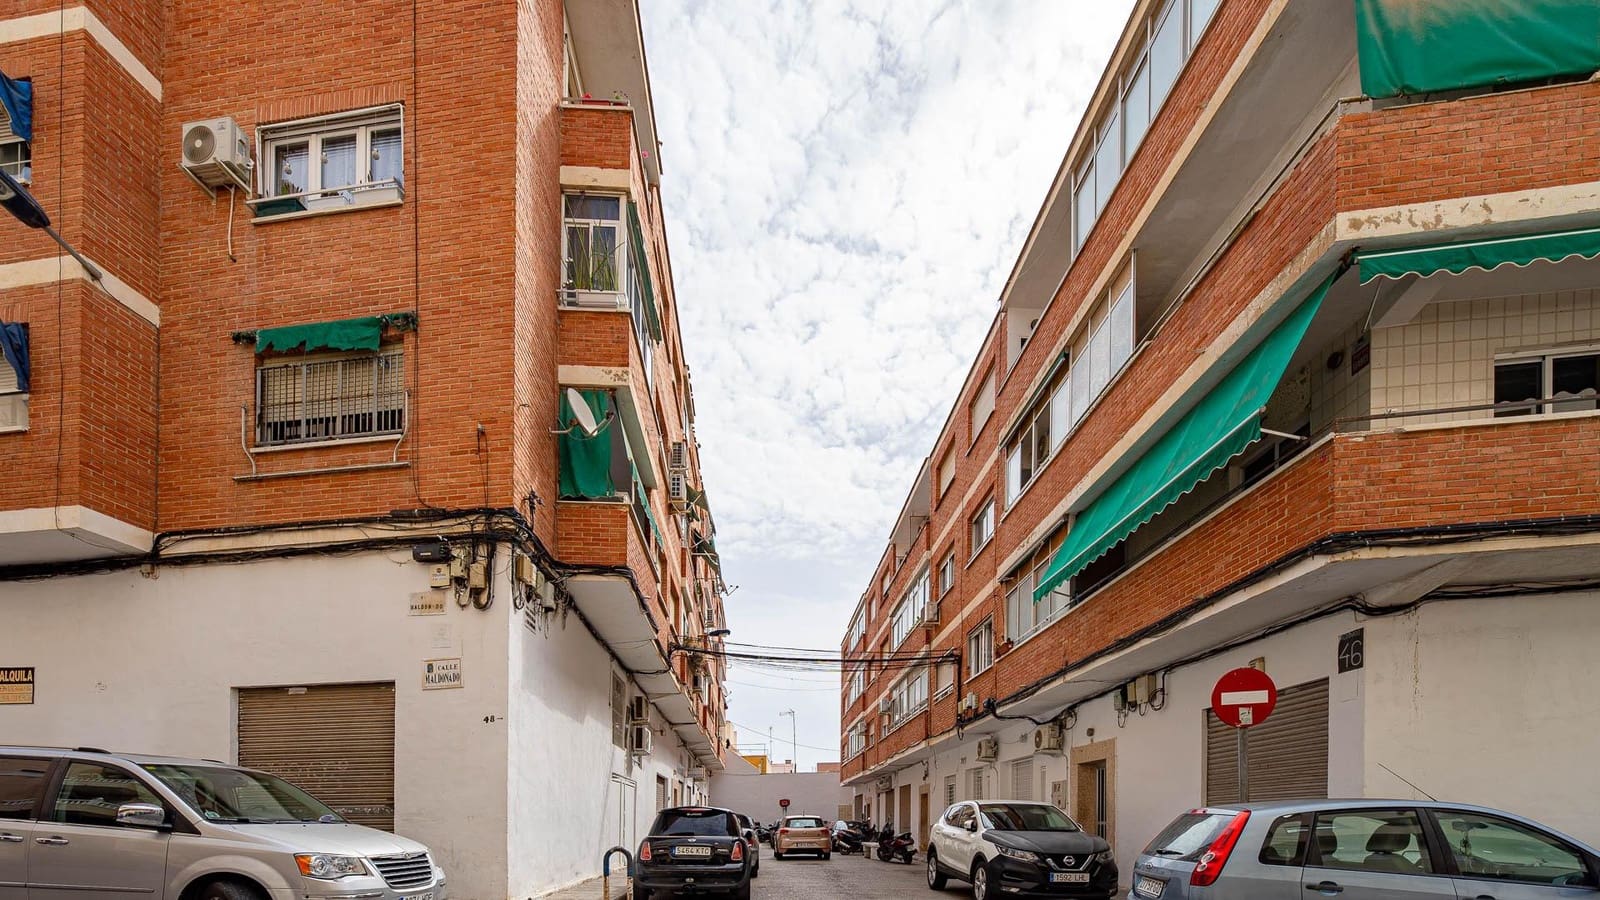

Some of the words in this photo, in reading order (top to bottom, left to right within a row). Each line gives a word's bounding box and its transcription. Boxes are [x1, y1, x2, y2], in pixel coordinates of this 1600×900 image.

[1339, 640, 1362, 668] 46
[437, 663, 458, 671] CALLE
[0, 670, 33, 681] ALQUILA
[425, 673, 460, 684] MALDONADO
[483, 715, 495, 723] 48
[1055, 873, 1072, 881] 1592
